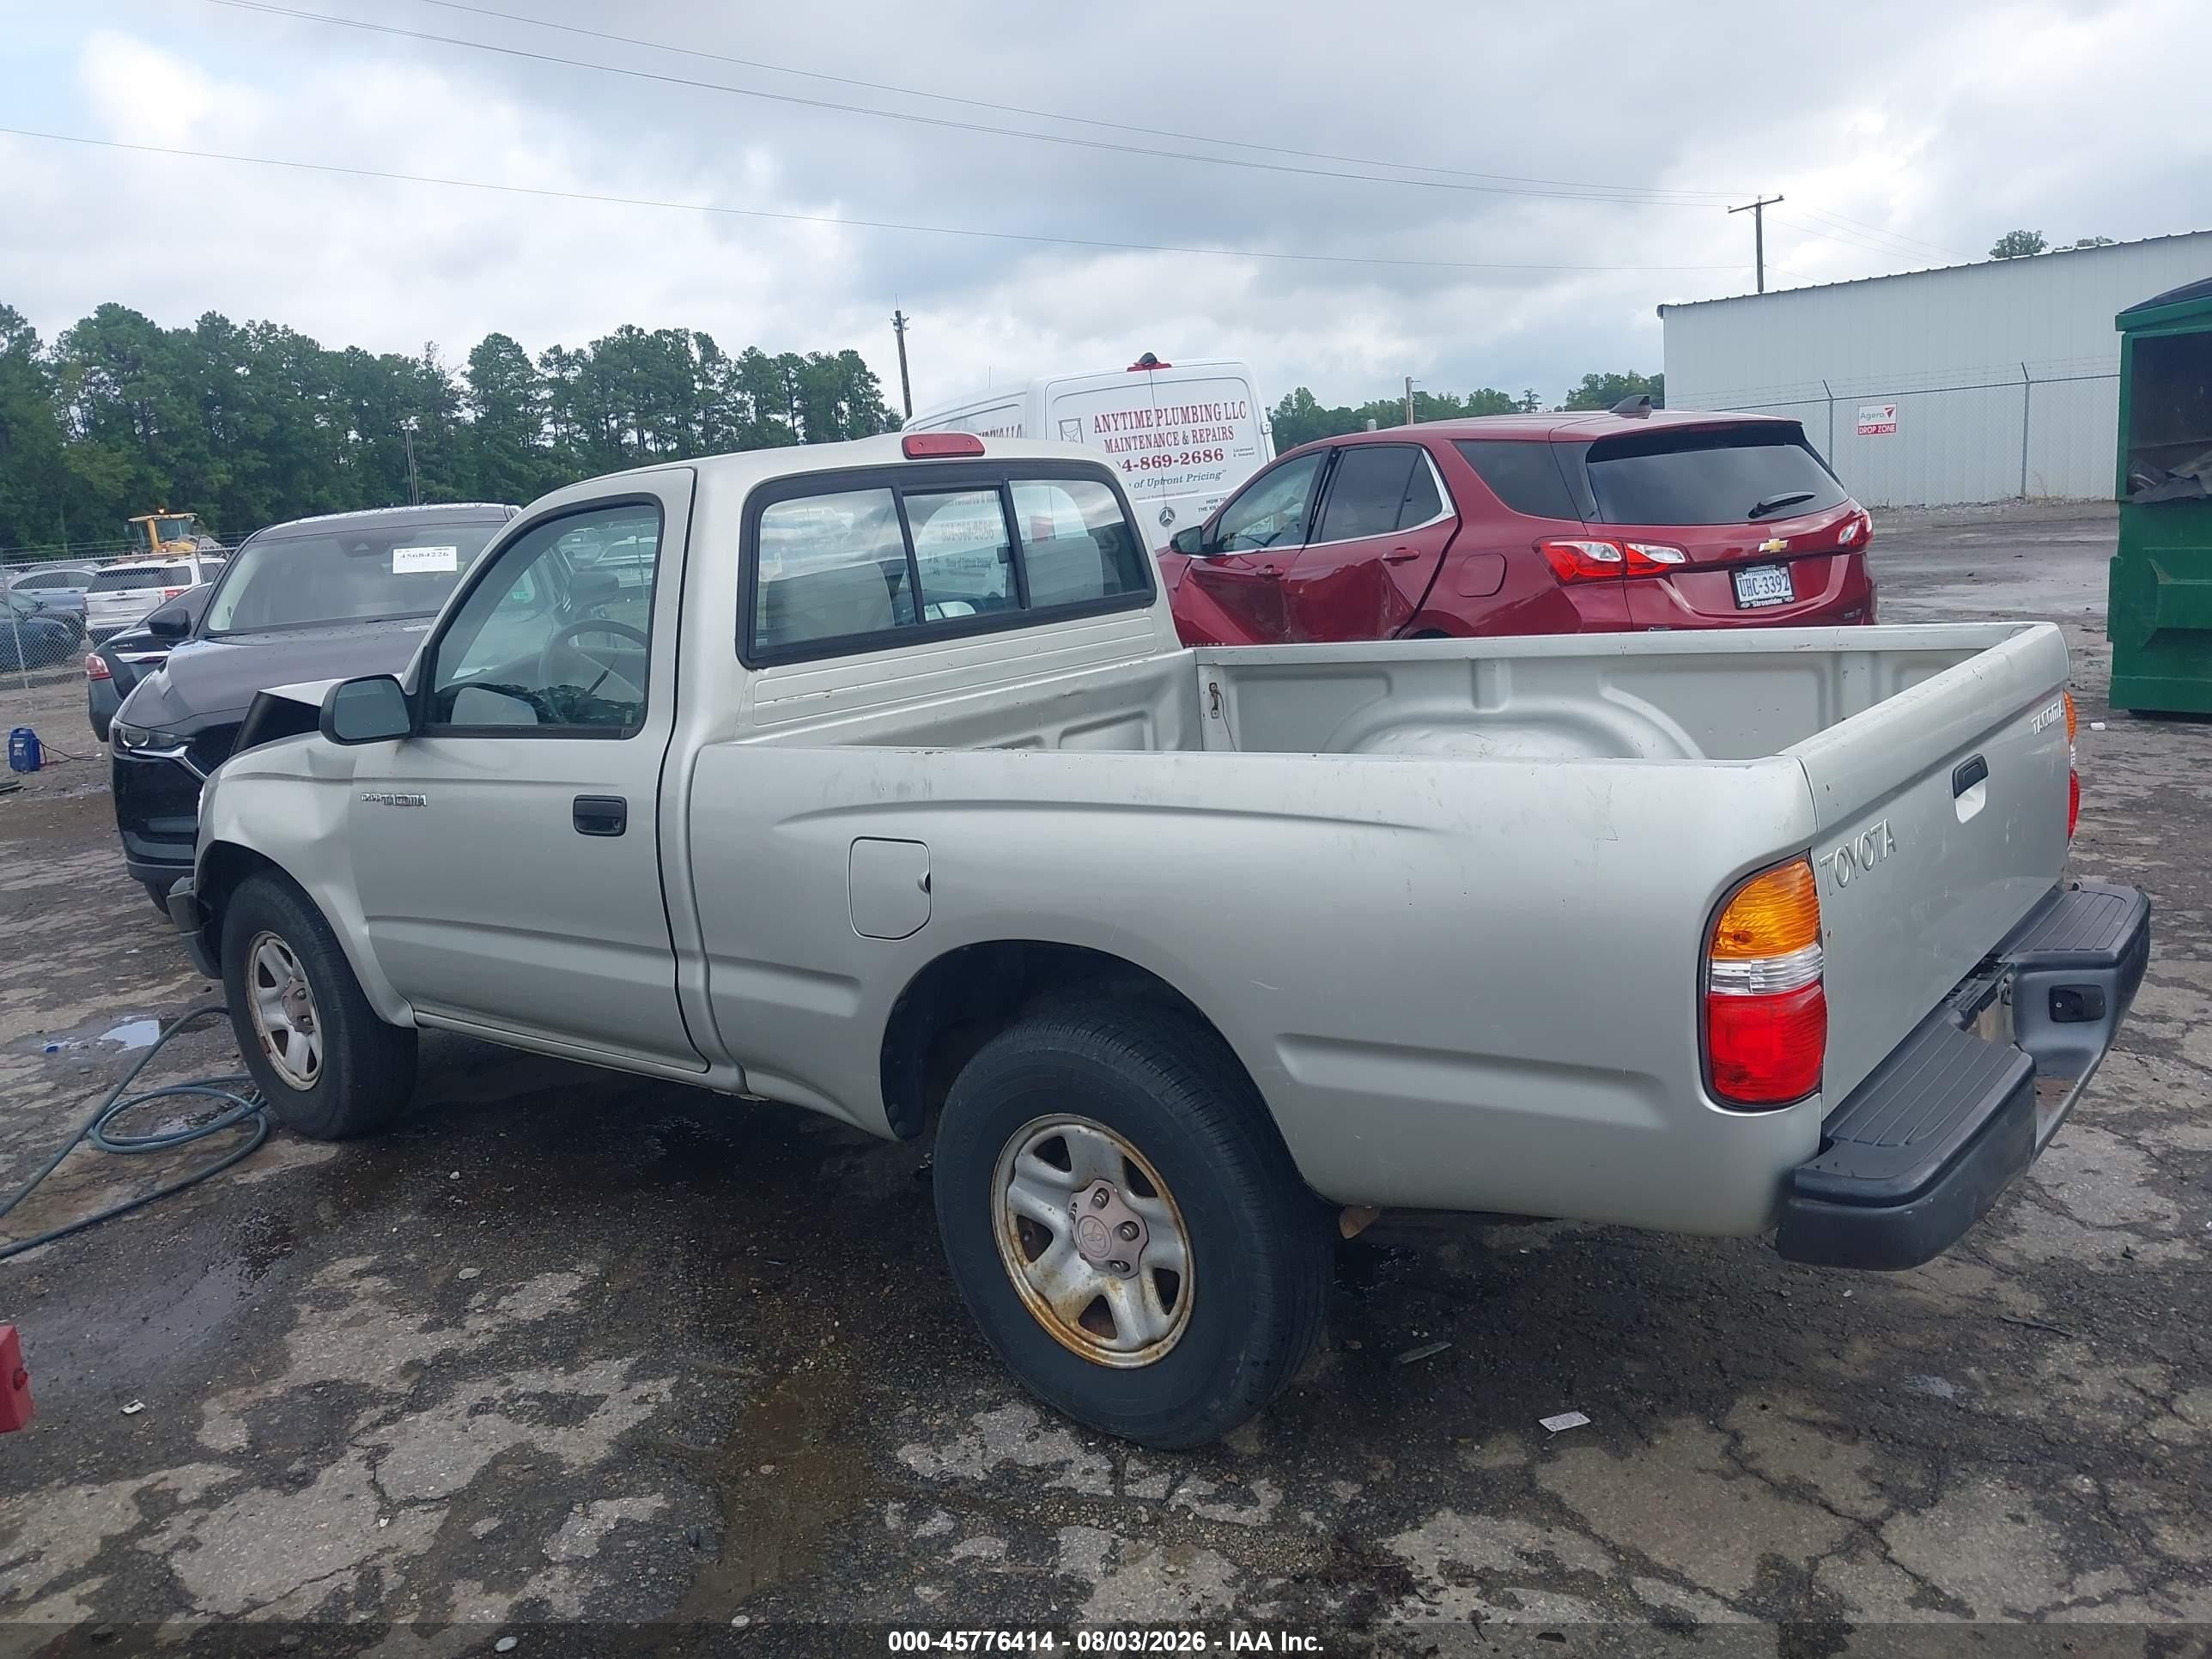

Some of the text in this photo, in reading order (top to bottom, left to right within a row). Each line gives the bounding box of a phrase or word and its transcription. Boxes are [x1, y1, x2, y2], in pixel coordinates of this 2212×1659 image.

[1094, 401, 1247, 434] ANYTIME PLUMBING LLC
[1859, 424, 1896, 434] DROP ZONE
[1860, 412, 1885, 421] Agero
[1104, 426, 1235, 453] MAINTENANCE & REPAIRS
[1116, 447, 1224, 472] 4-869-2686
[1133, 477, 1145, 489] of
[1147, 475, 1183, 489] Upfront
[1737, 574, 1790, 597] UHC-3392
[2031, 700, 2064, 736] TACOMA
[1820, 818, 1897, 896] TOYOTA
